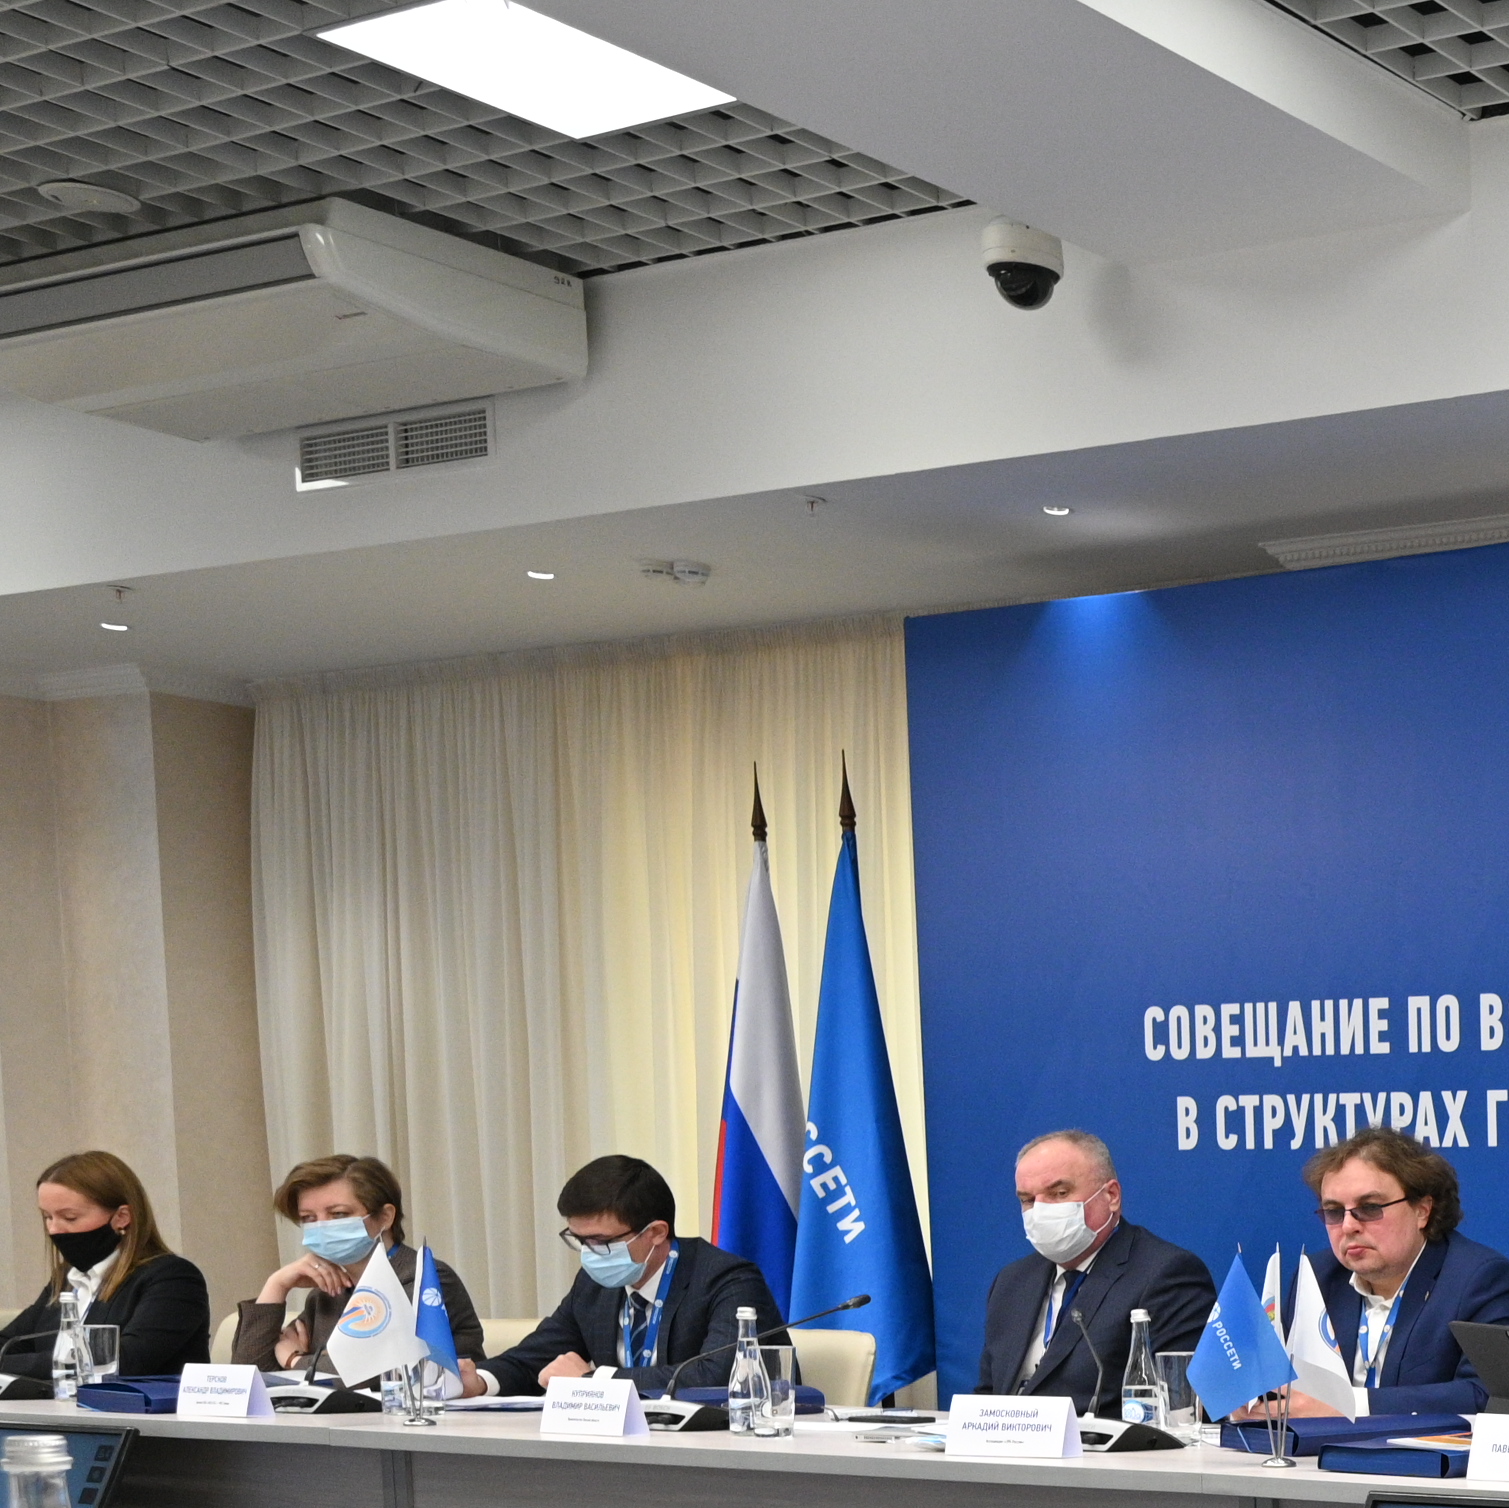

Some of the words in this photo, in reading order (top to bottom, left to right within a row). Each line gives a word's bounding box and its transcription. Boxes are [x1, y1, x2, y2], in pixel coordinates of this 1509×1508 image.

[1143, 997, 1391, 1067] СОВЕЩАНИЕ
[1407, 995, 1460, 1053] ПО
[1176, 1096, 1199, 1151] В
[1215, 1090, 1470, 1150] СТРУКТУРАХ
[1212, 1321, 1242, 1370] РОССЕТИ
[962, 1420, 999, 1434] АРКАДИЙ
[1001, 1421, 1052, 1433] ВИКТОРОВИЧ
[978, 1407, 1039, 1419] ЗАМОСКОВНЫЙ
